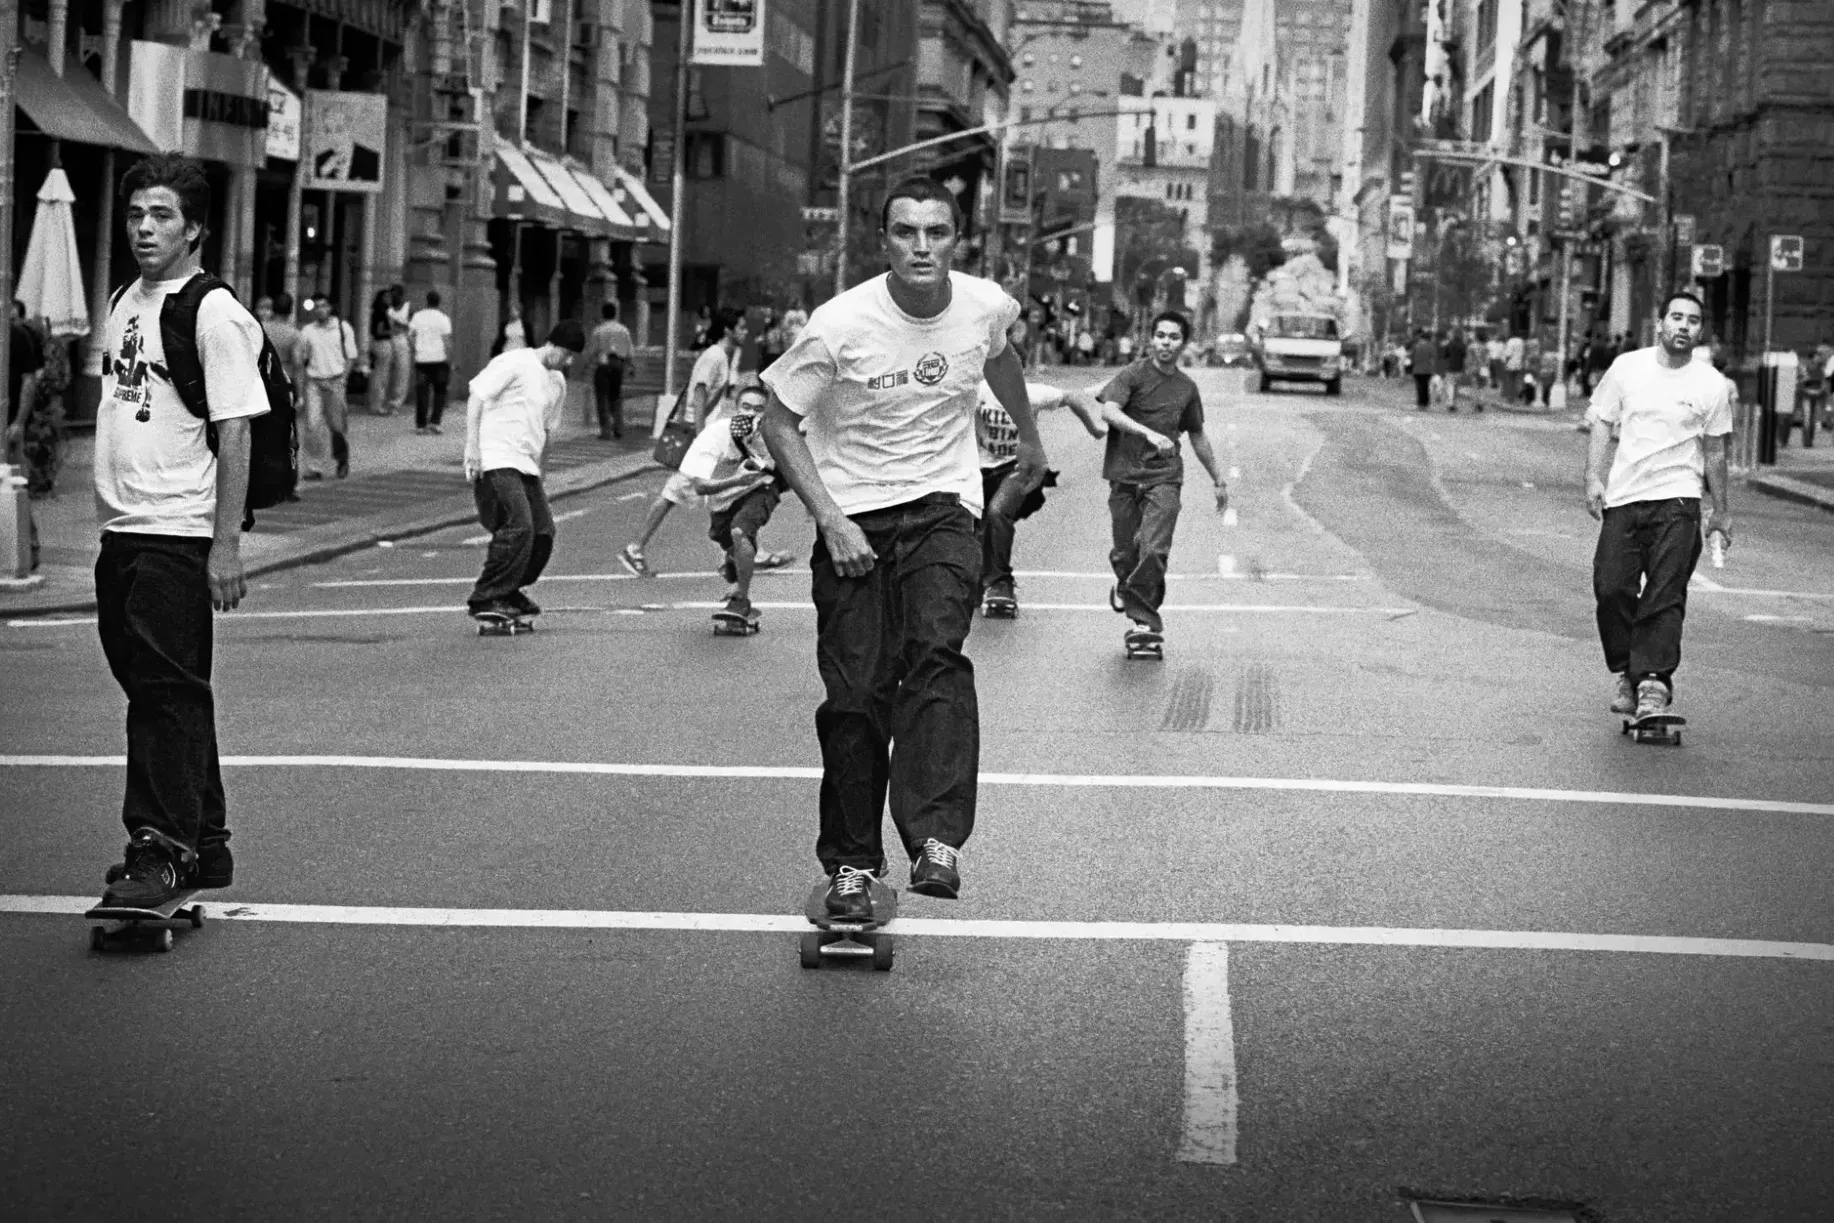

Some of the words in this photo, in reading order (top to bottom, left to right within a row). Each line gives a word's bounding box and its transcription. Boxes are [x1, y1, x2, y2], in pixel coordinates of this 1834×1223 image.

[113, 386, 142, 403] SUPREME
[982, 408, 1010, 425] KIL
[979, 437, 1017, 456] LADE
